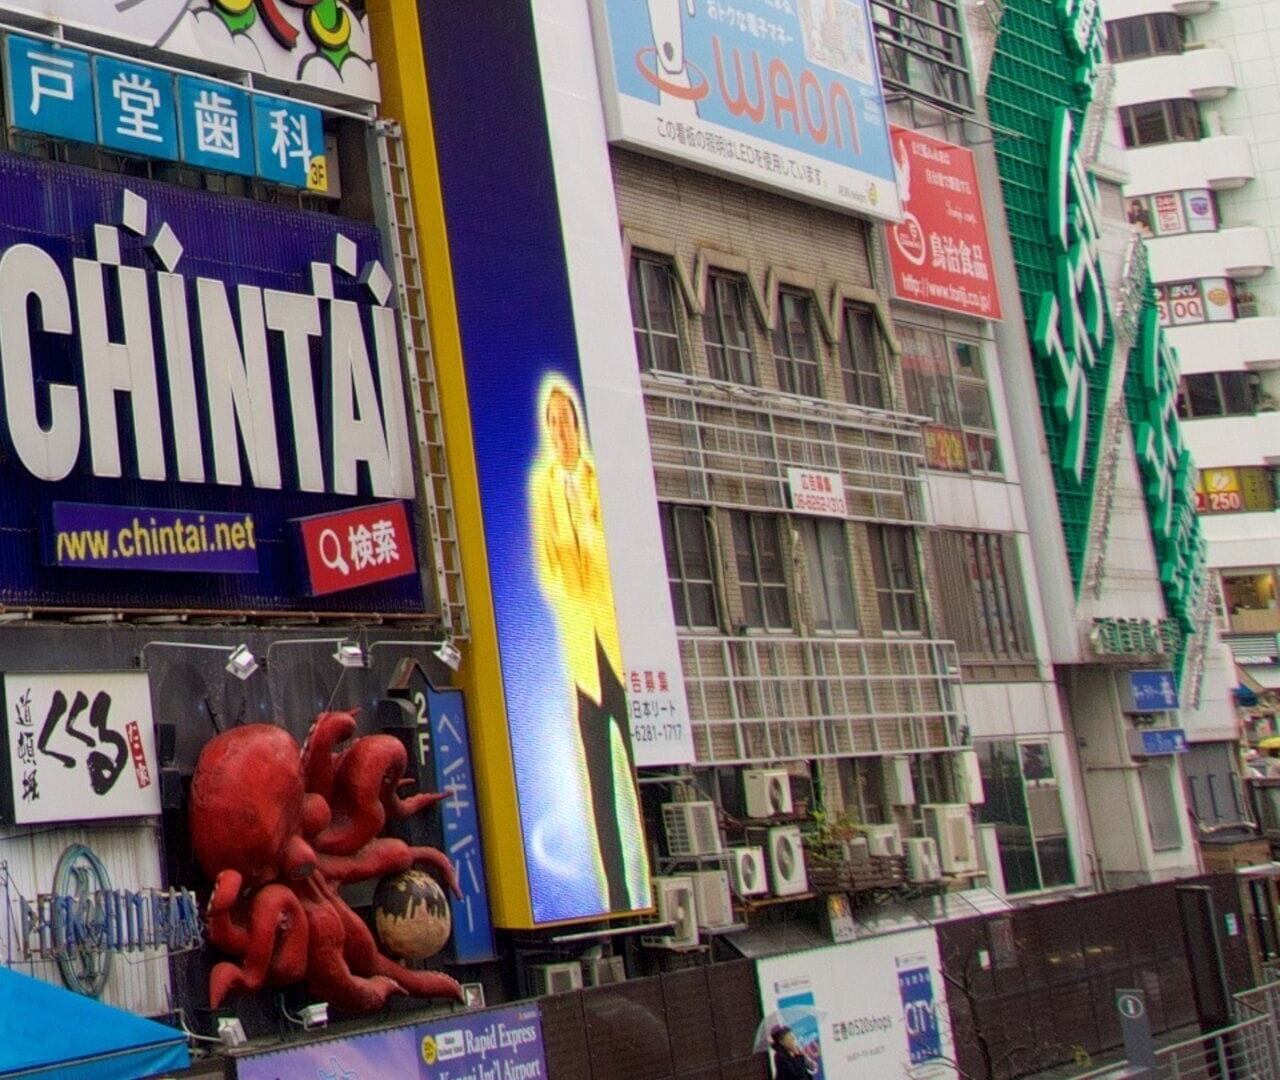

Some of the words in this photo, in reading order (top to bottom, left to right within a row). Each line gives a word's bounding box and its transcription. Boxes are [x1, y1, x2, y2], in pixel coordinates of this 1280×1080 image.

[27, 51, 313, 175] 戸堂歯科
[711, 34, 863, 156] WAON
[309, 162, 327, 187] 3F
[348, 518, 401, 570] 検索
[414, 691, 430, 766] 2F
[464, 1024, 497, 1059] Rapid
[498, 1022, 538, 1054] Express
